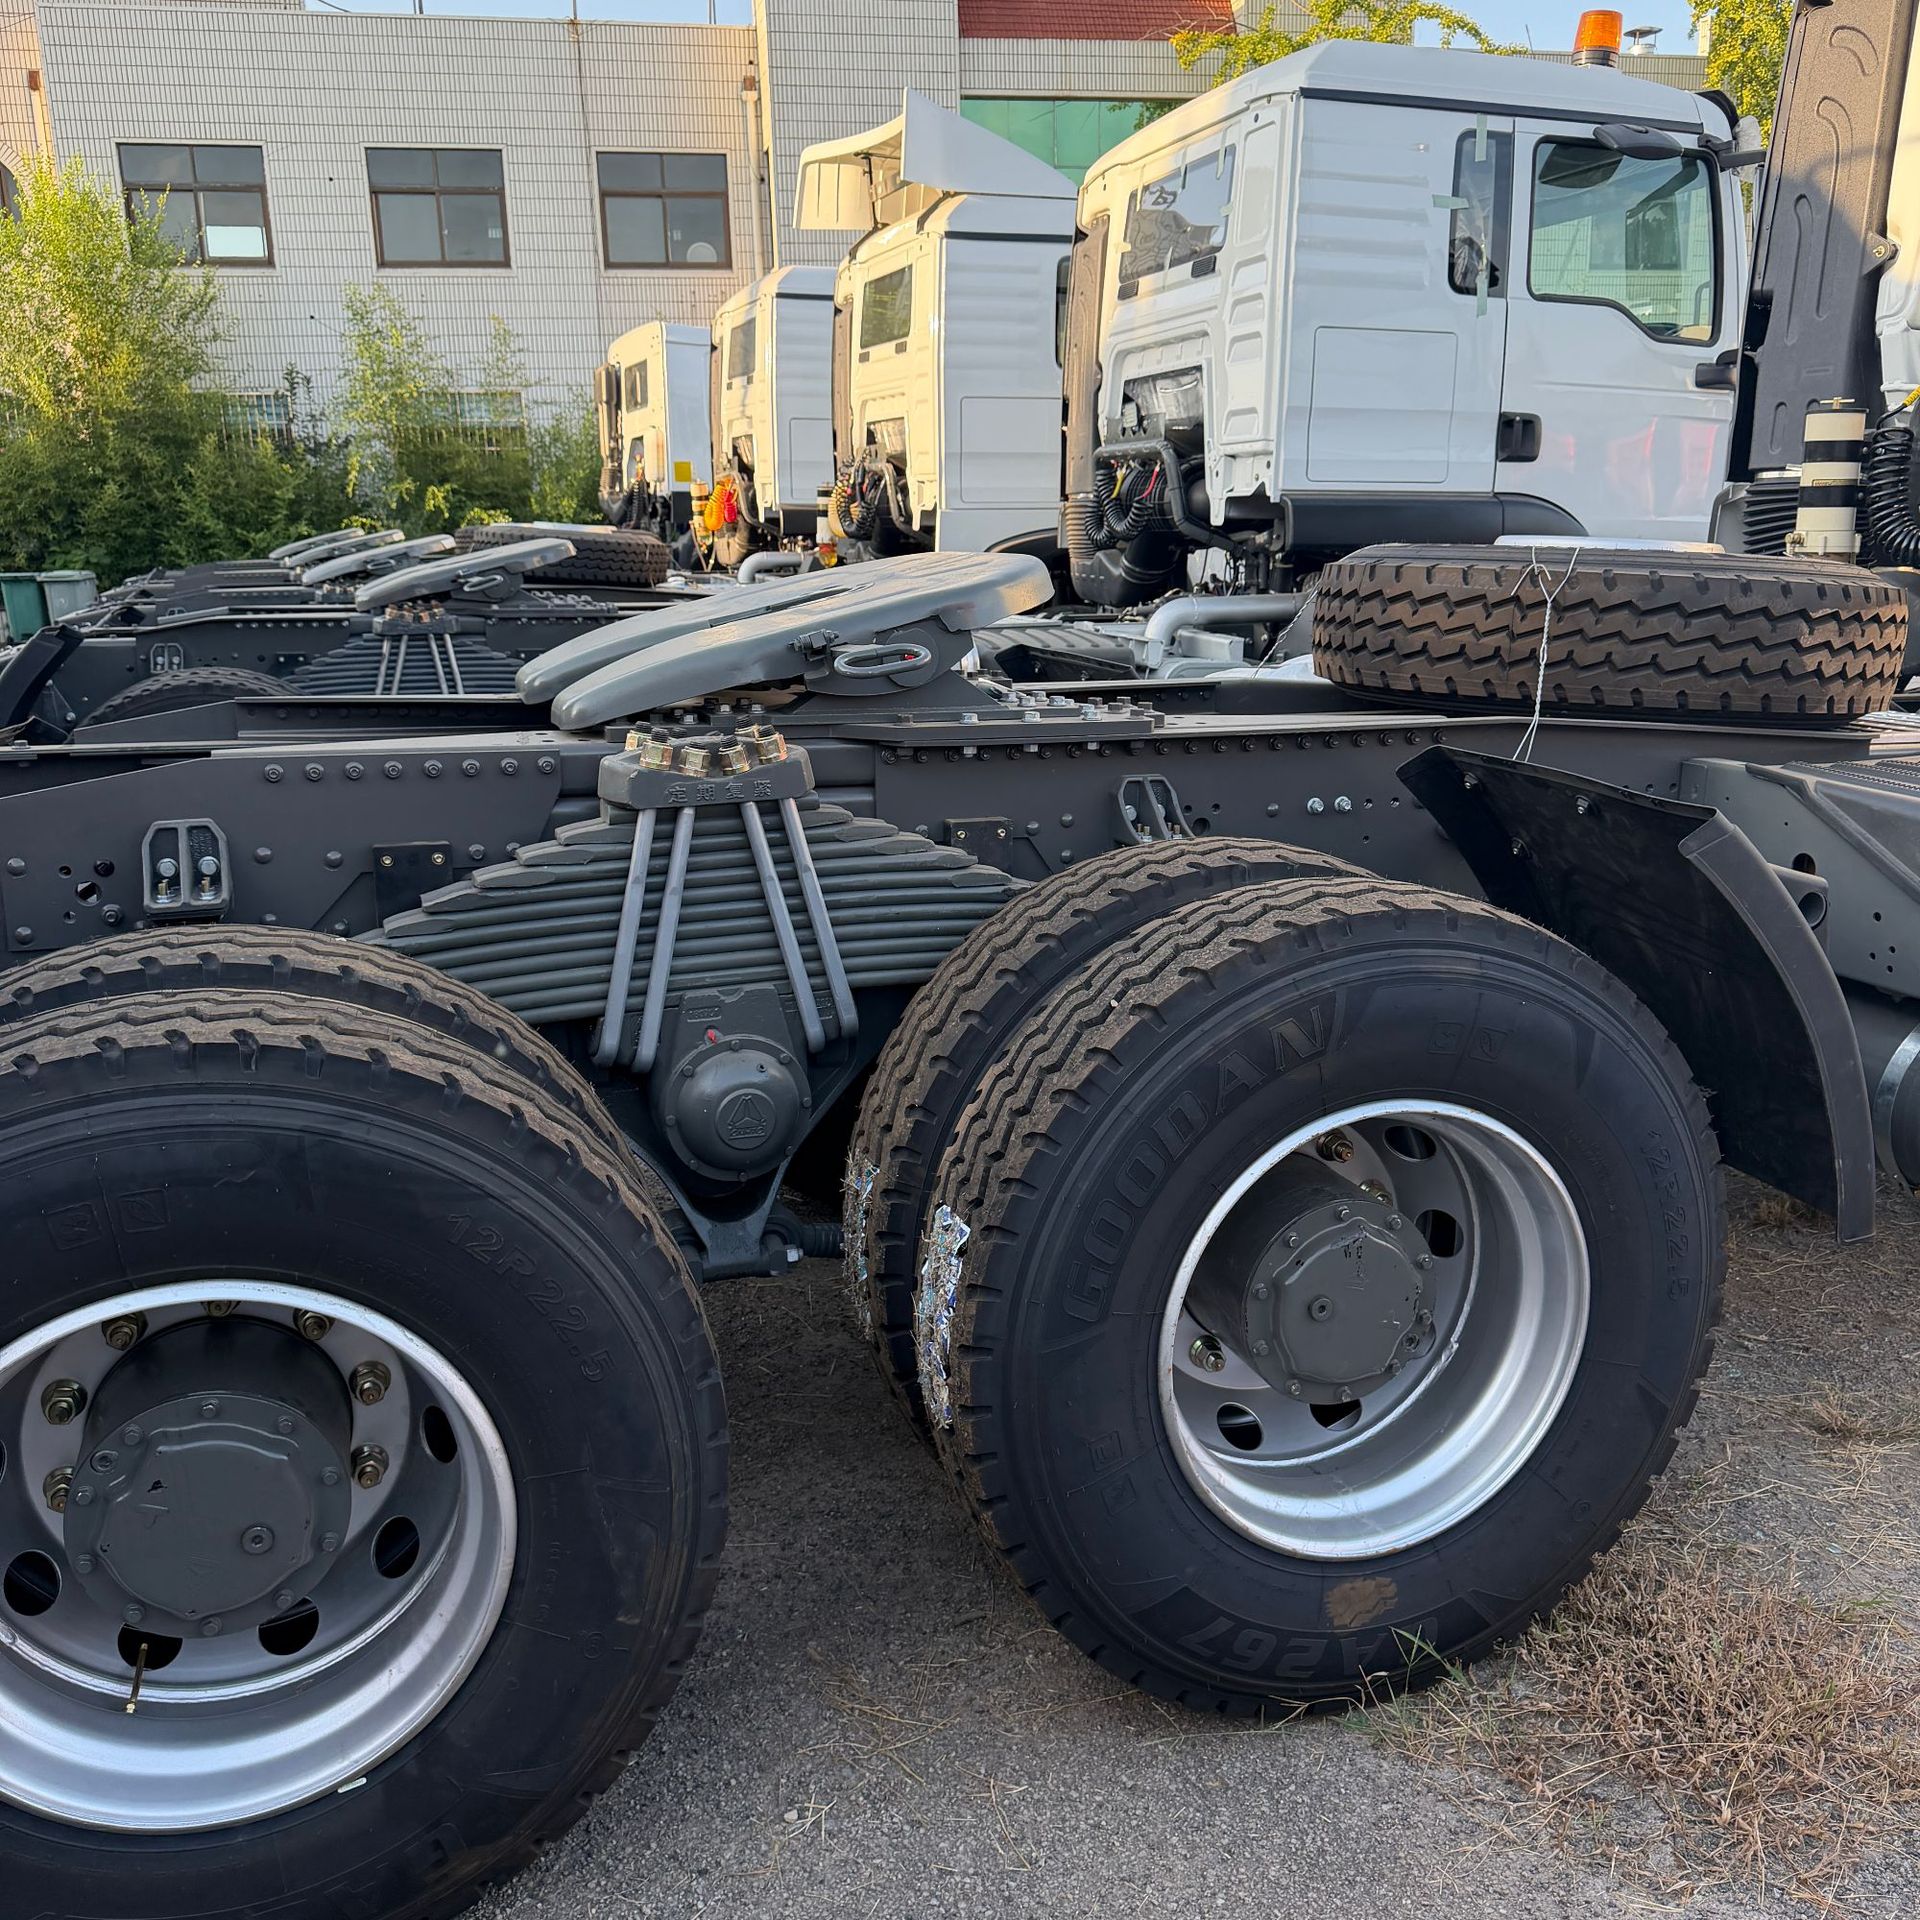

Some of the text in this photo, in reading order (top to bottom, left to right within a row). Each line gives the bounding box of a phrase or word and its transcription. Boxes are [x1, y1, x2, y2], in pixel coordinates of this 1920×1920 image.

[664, 779, 773, 804] 定期复紧
[1062, 1004, 1325, 1322] GOODAN
[447, 1213, 617, 1383] 12R22.5
